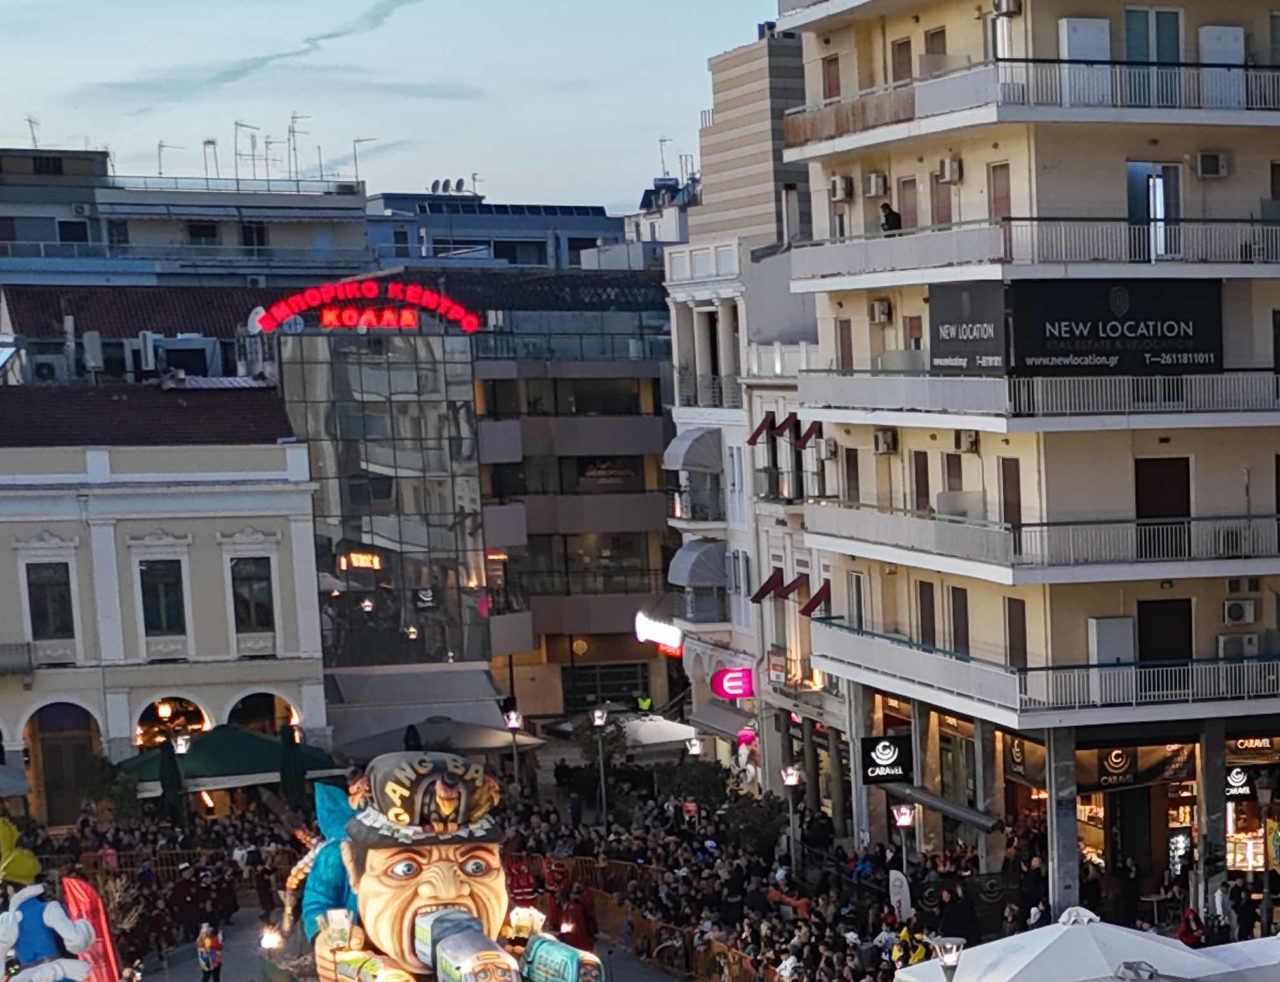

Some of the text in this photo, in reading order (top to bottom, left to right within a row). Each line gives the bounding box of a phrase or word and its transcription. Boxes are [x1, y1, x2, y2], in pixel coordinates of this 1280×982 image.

[386, 281, 480, 334] ΚΕΝΤΡΟ
[939, 323, 995, 340] NEW LOCATION
[1045, 321, 1194, 338] NEW LOCATION
[1025, 353, 1120, 367] www.newlocation.gr
[1237, 738, 1271, 749] CARAVEL
[867, 766, 904, 777] CARAVEL
[384, 757, 434, 826] GANG
